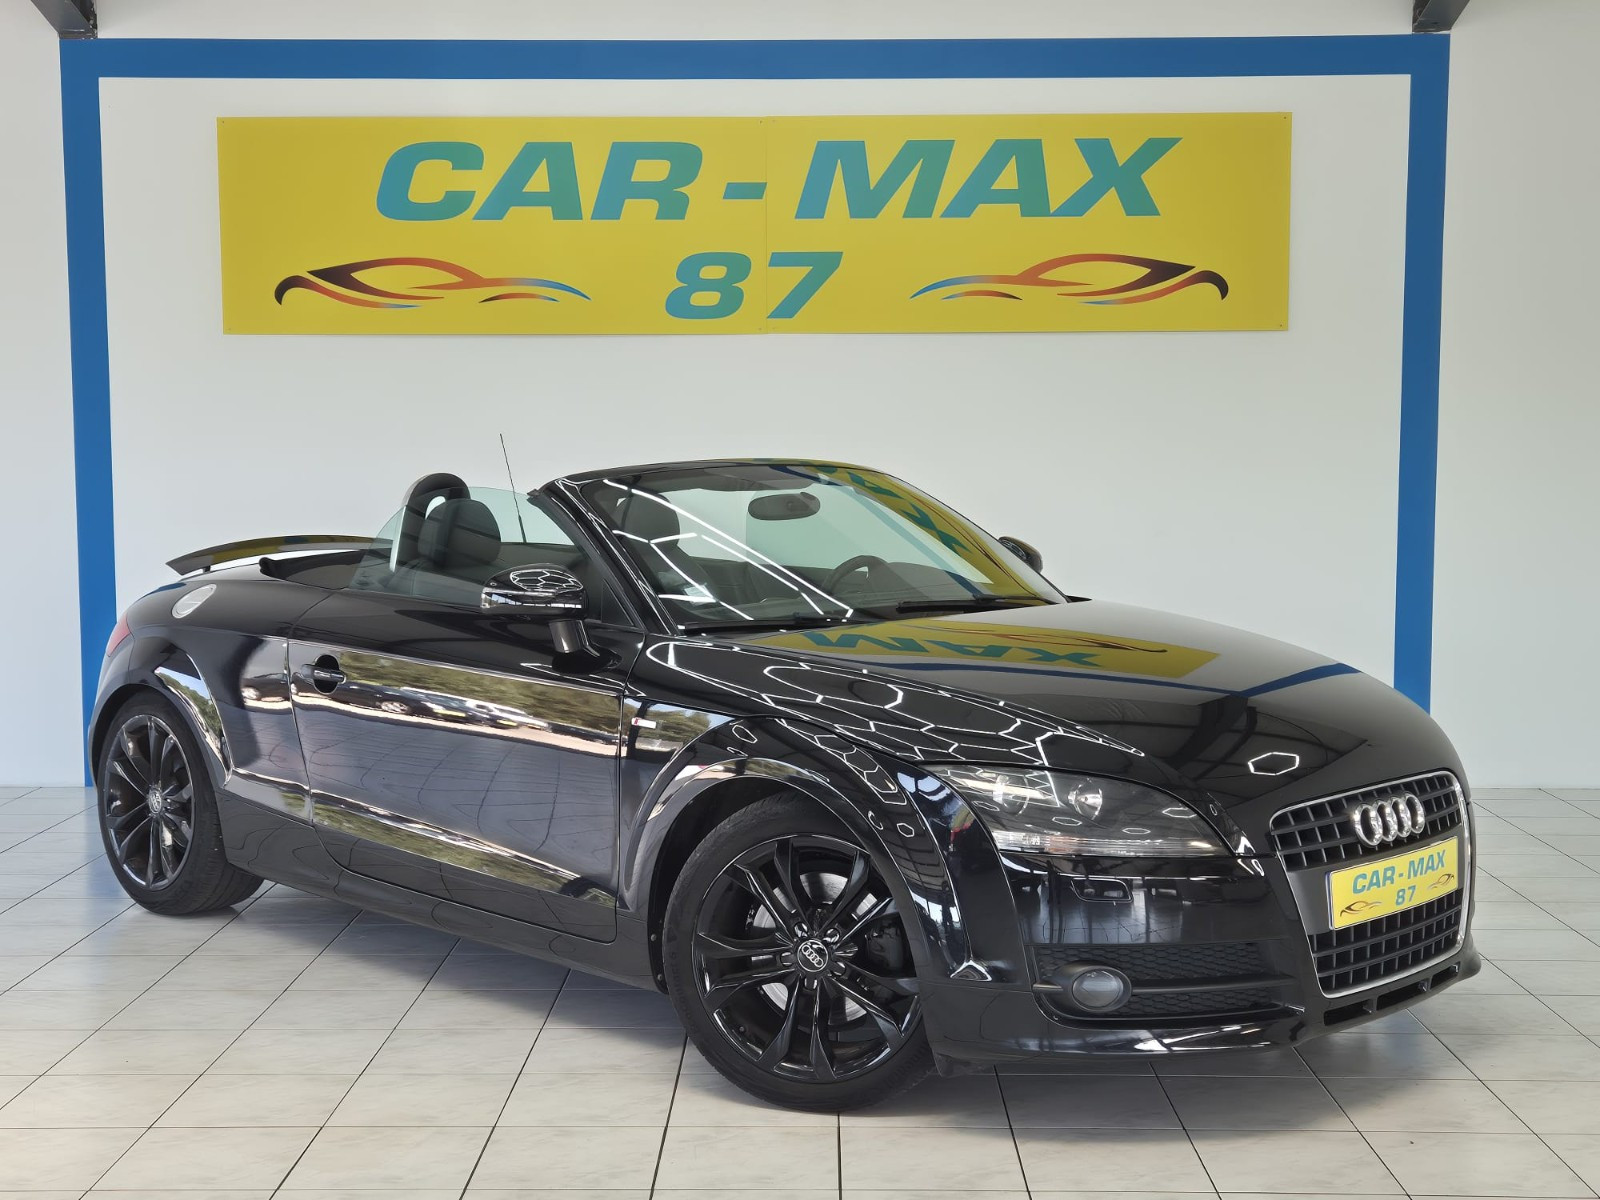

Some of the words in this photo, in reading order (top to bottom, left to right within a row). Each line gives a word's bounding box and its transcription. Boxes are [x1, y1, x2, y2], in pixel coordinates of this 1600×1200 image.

[376, 141, 703, 222] CAR
[795, 137, 1182, 219] MAX
[665, 251, 844, 320] 87
[1395, 885, 1417, 906] 87
